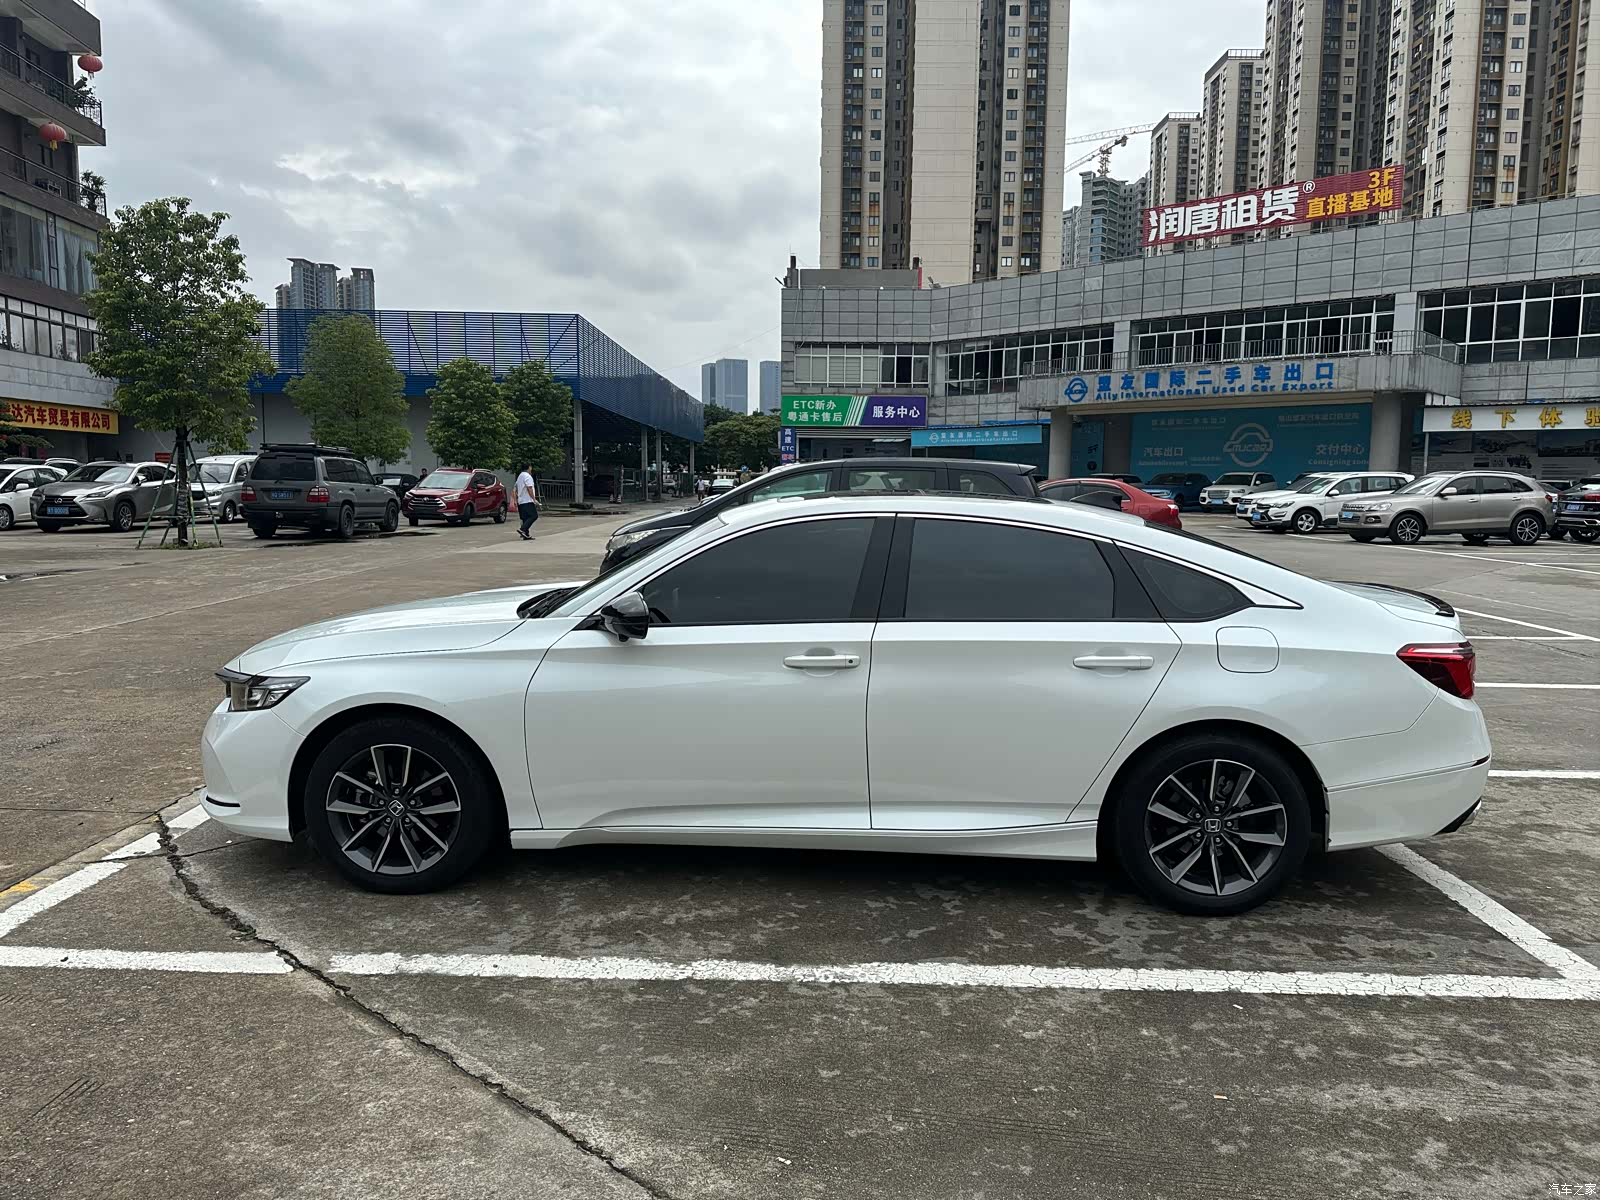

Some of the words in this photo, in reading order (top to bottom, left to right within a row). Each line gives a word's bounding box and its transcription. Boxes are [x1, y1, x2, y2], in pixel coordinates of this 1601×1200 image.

[1368, 167, 1396, 189] 3F
[1306, 187, 1394, 220] 直播基地
[1148, 185, 1300, 243] 润唐租赁
[1097, 362, 1335, 392] 盟友国际二手车出口
[1120, 386, 1207, 399] International
[1211, 384, 1245, 395] Used
[1251, 382, 1276, 393] Car
[1281, 380, 1335, 392] Export
[793, 399, 837, 410] ETC新办
[872, 405, 921, 419] 服务中心
[0, 402, 111, 430] 达汽车贸易有限公司
[787, 411, 843, 422] 粤通卡售后
[1143, 446, 1184, 457] 汽车出口
[1315, 442, 1365, 456] 交付中心
